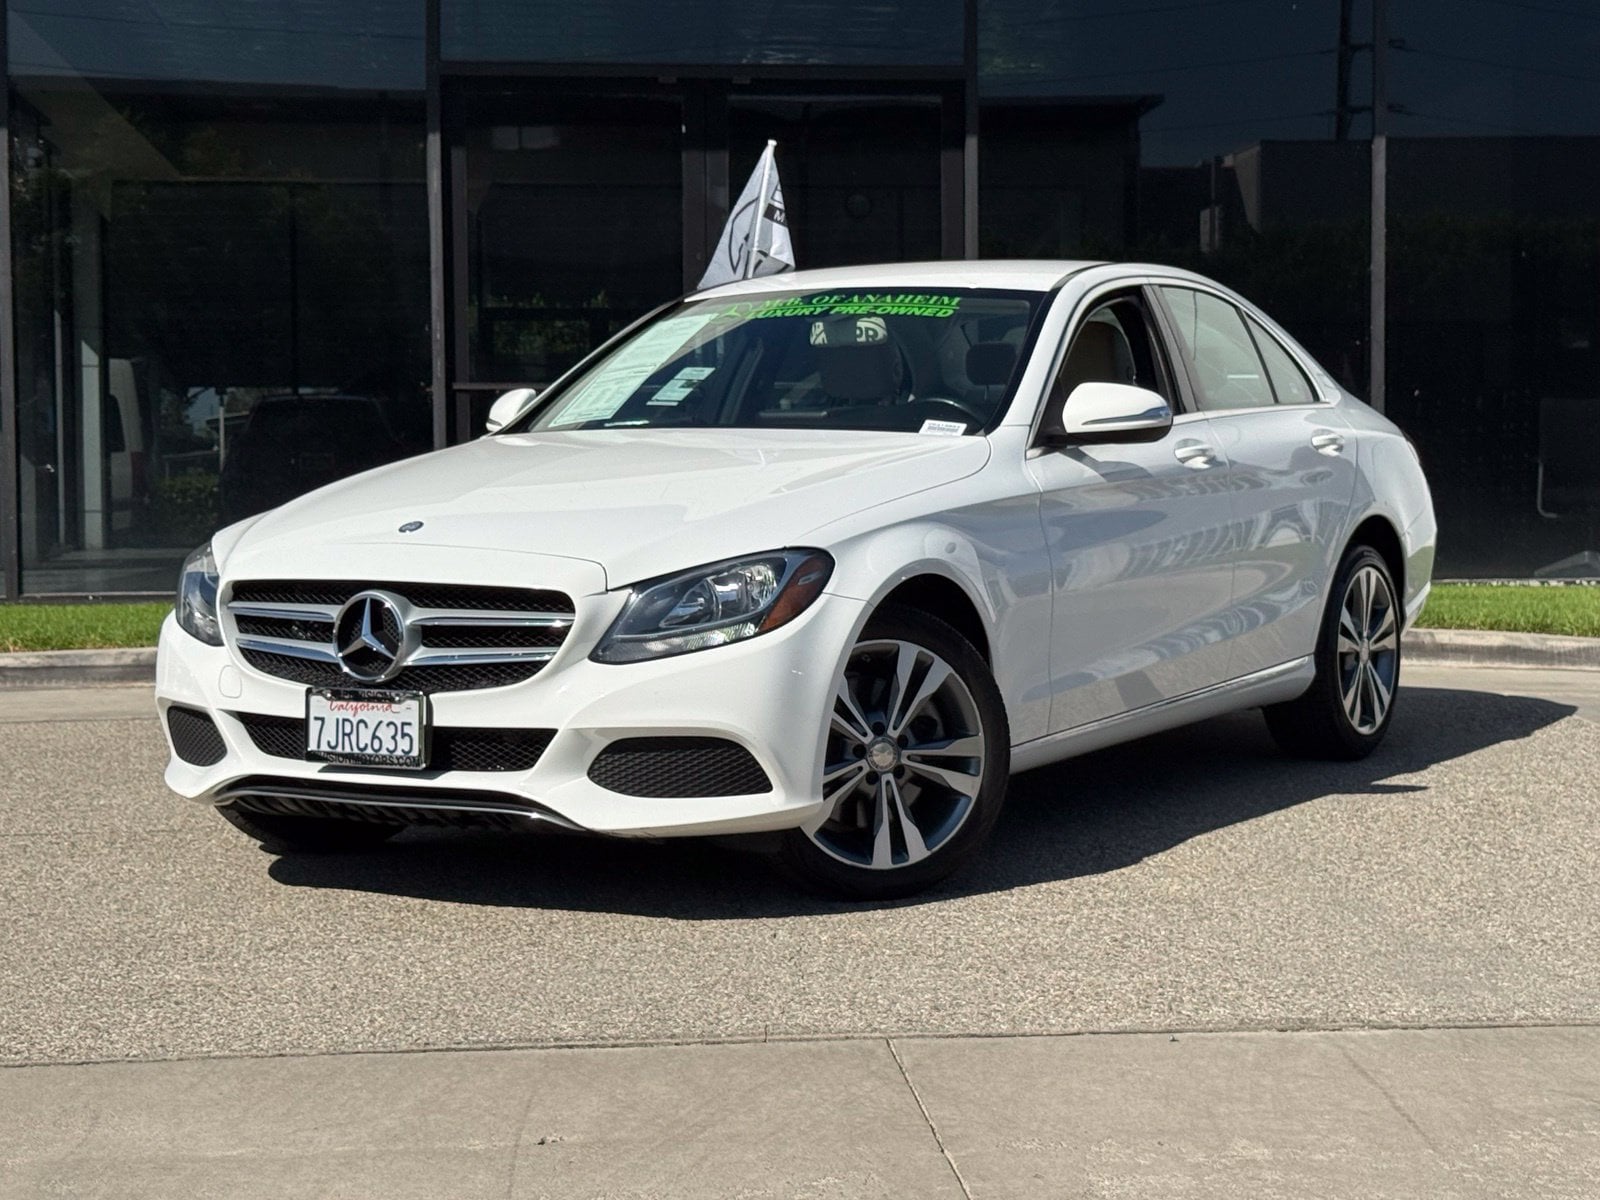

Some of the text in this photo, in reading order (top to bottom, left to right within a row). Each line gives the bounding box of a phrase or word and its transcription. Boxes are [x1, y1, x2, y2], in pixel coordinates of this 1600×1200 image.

[812, 294, 846, 305] OF
[844, 293, 961, 306] ANAHEIM
[745, 305, 955, 320] LUXURY PRE-OWNED
[328, 700, 401, 717] California
[313, 716, 414, 755] 7JRC635
